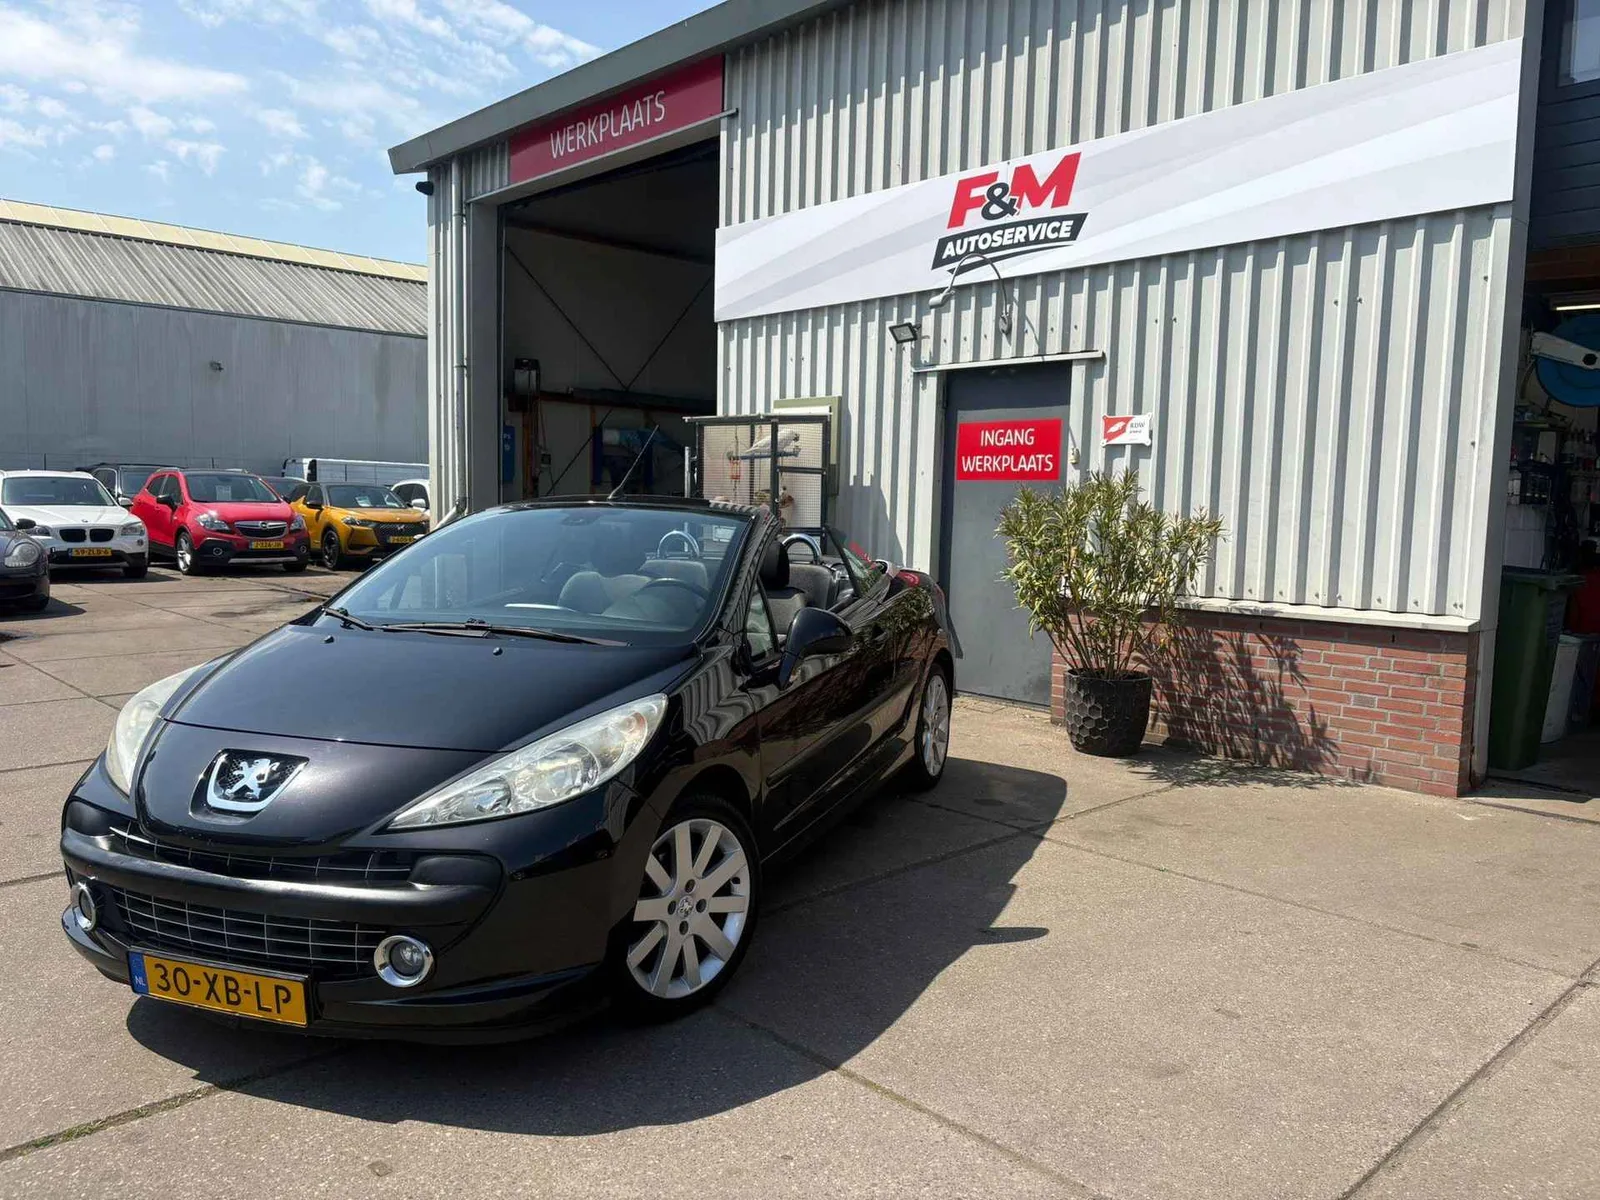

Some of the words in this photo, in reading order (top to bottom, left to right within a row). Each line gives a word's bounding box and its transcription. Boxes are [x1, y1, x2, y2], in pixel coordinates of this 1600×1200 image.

[550, 90, 665, 159] WERKPLAATS
[947, 152, 1082, 229] F&M
[942, 220, 1074, 259] AUTOSERVICE
[980, 428, 1035, 447] INGANG
[962, 454, 1054, 473] WERKPLAATS
[135, 975, 146, 987] NL
[154, 963, 291, 1014] 30-XB-LP
